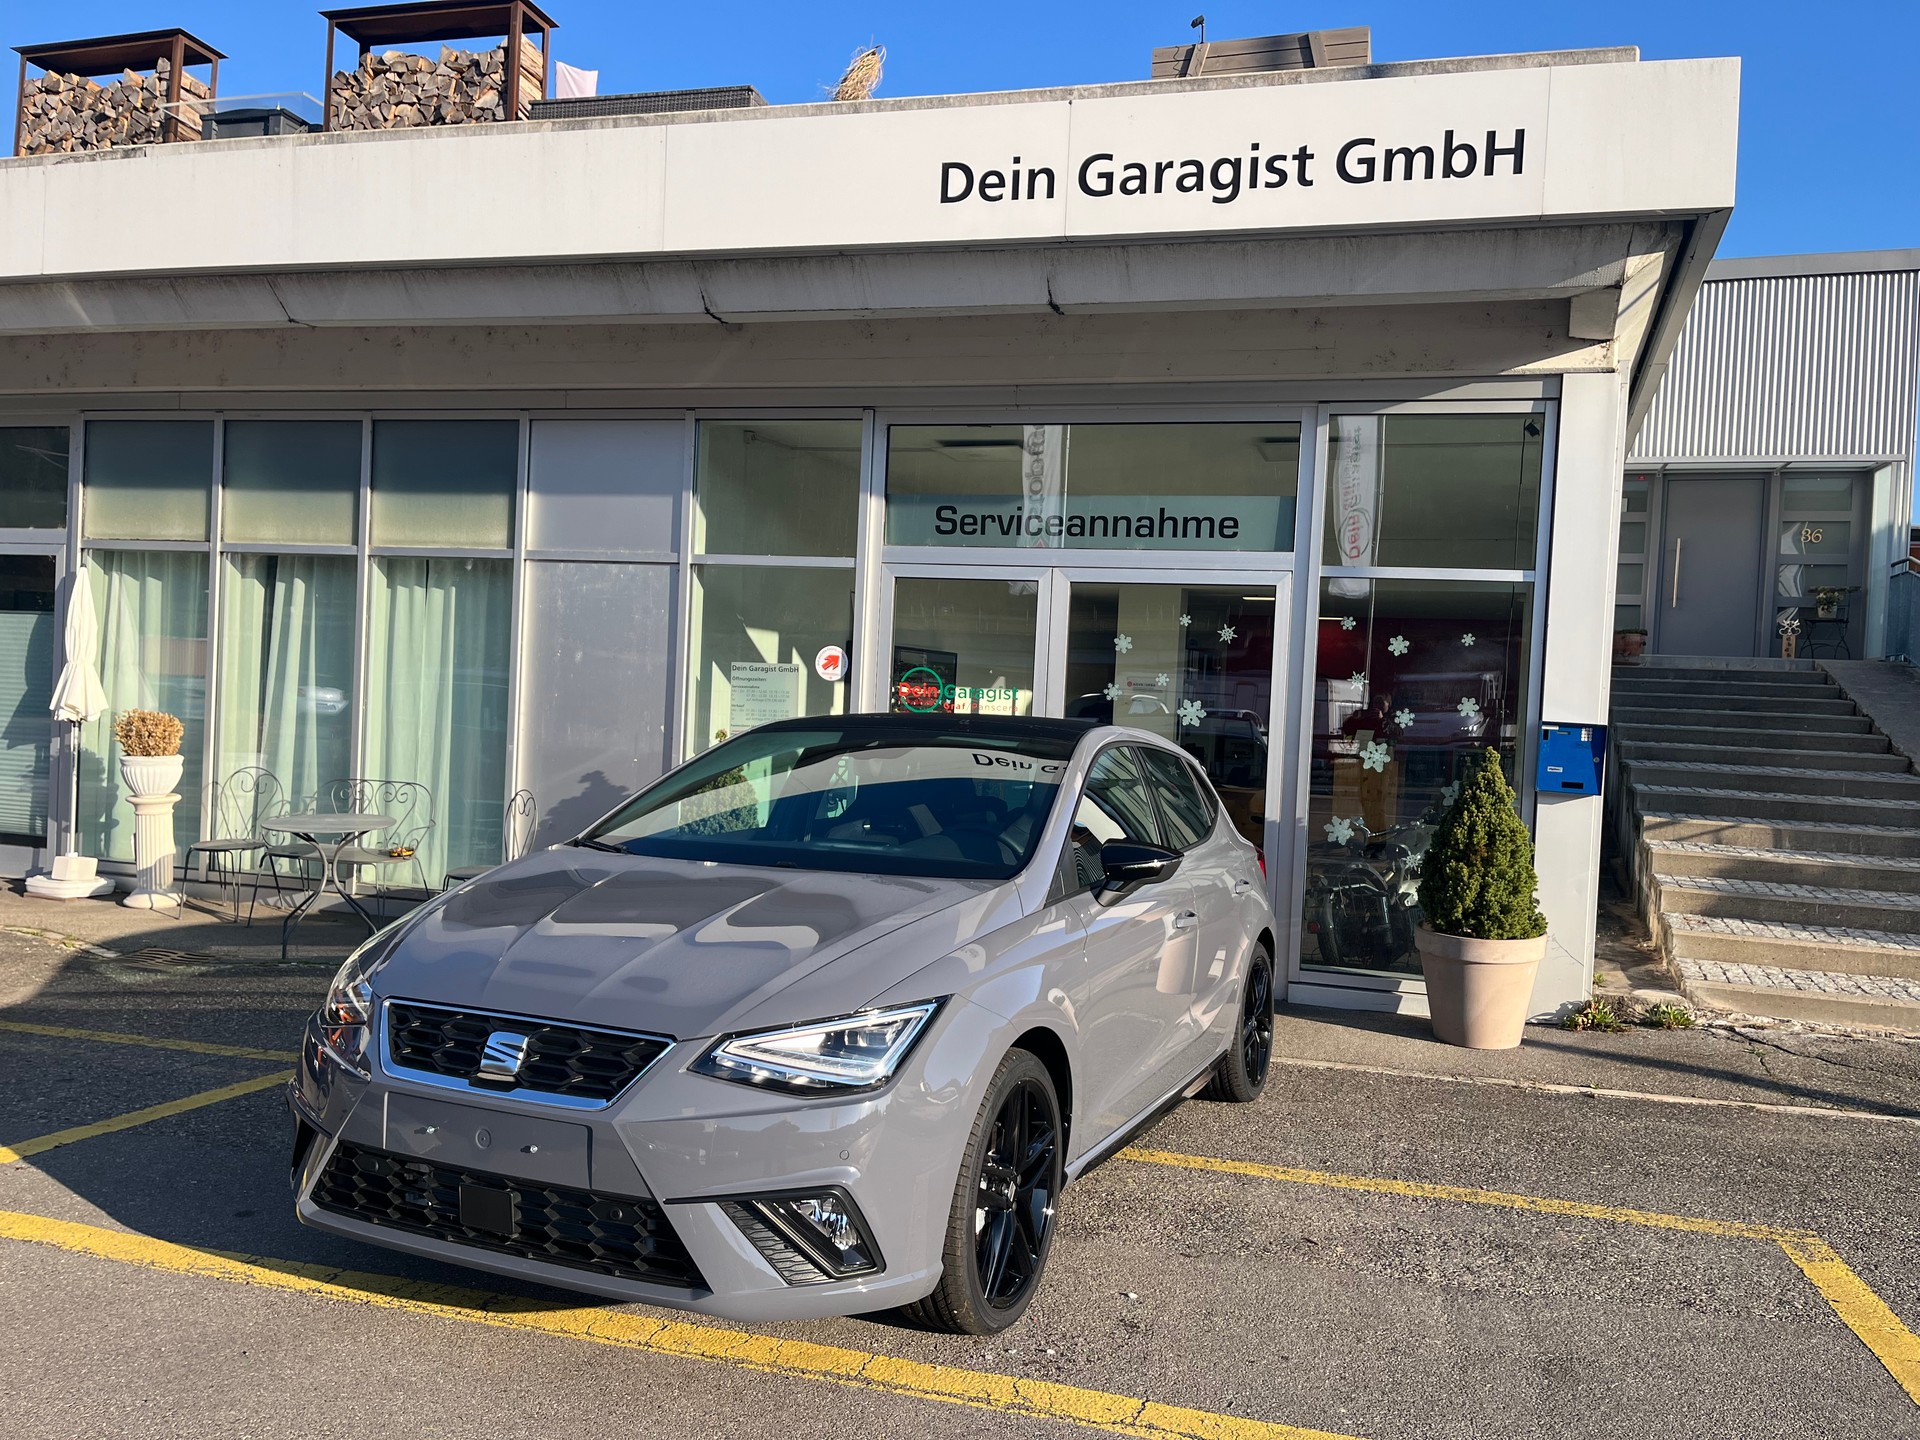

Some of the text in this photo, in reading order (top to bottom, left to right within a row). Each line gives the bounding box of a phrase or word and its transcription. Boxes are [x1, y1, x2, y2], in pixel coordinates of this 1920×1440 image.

[940, 128, 1526, 204] Dein Garagist GmbH
[935, 505, 1239, 539] Serviceannahme
[1800, 528, 1823, 543] 36
[749, 665, 777, 673] Garagist
[898, 682, 1018, 702] Dein Garagist
